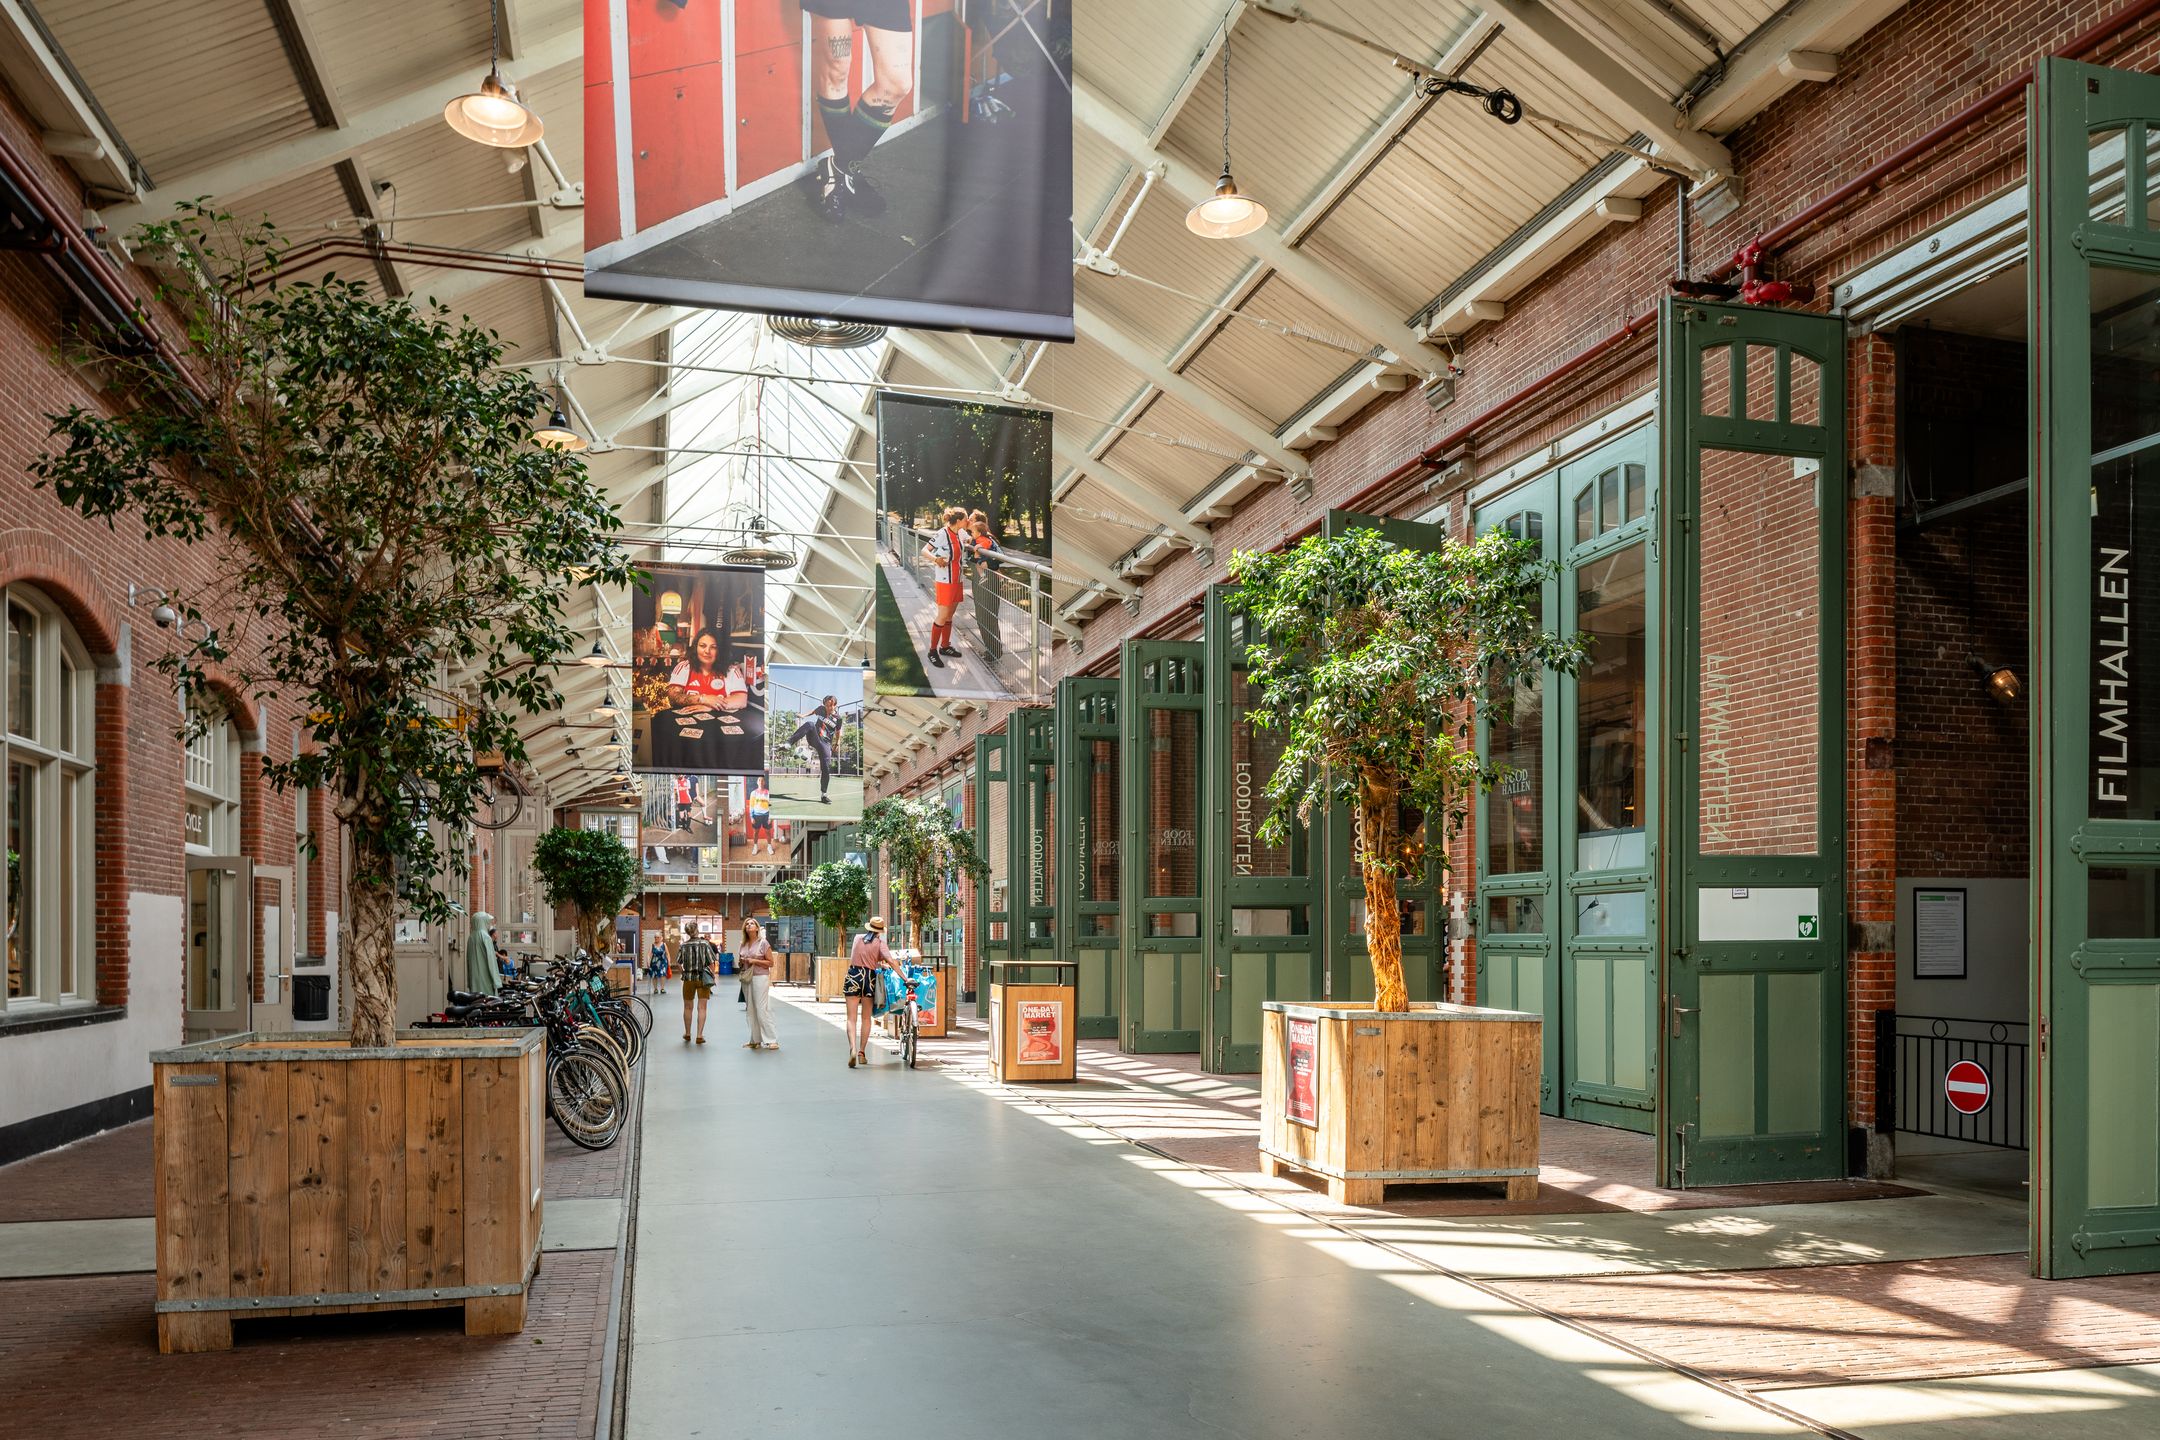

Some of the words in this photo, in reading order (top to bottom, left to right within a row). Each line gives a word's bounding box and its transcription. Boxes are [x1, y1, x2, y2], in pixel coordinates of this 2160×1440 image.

[2097, 547, 2129, 802] FILMHALLEN
[1504, 769, 1528, 784] FOOD
[1502, 780, 1531, 795] HALLEN
[1291, 1033, 1316, 1046] MARKET
